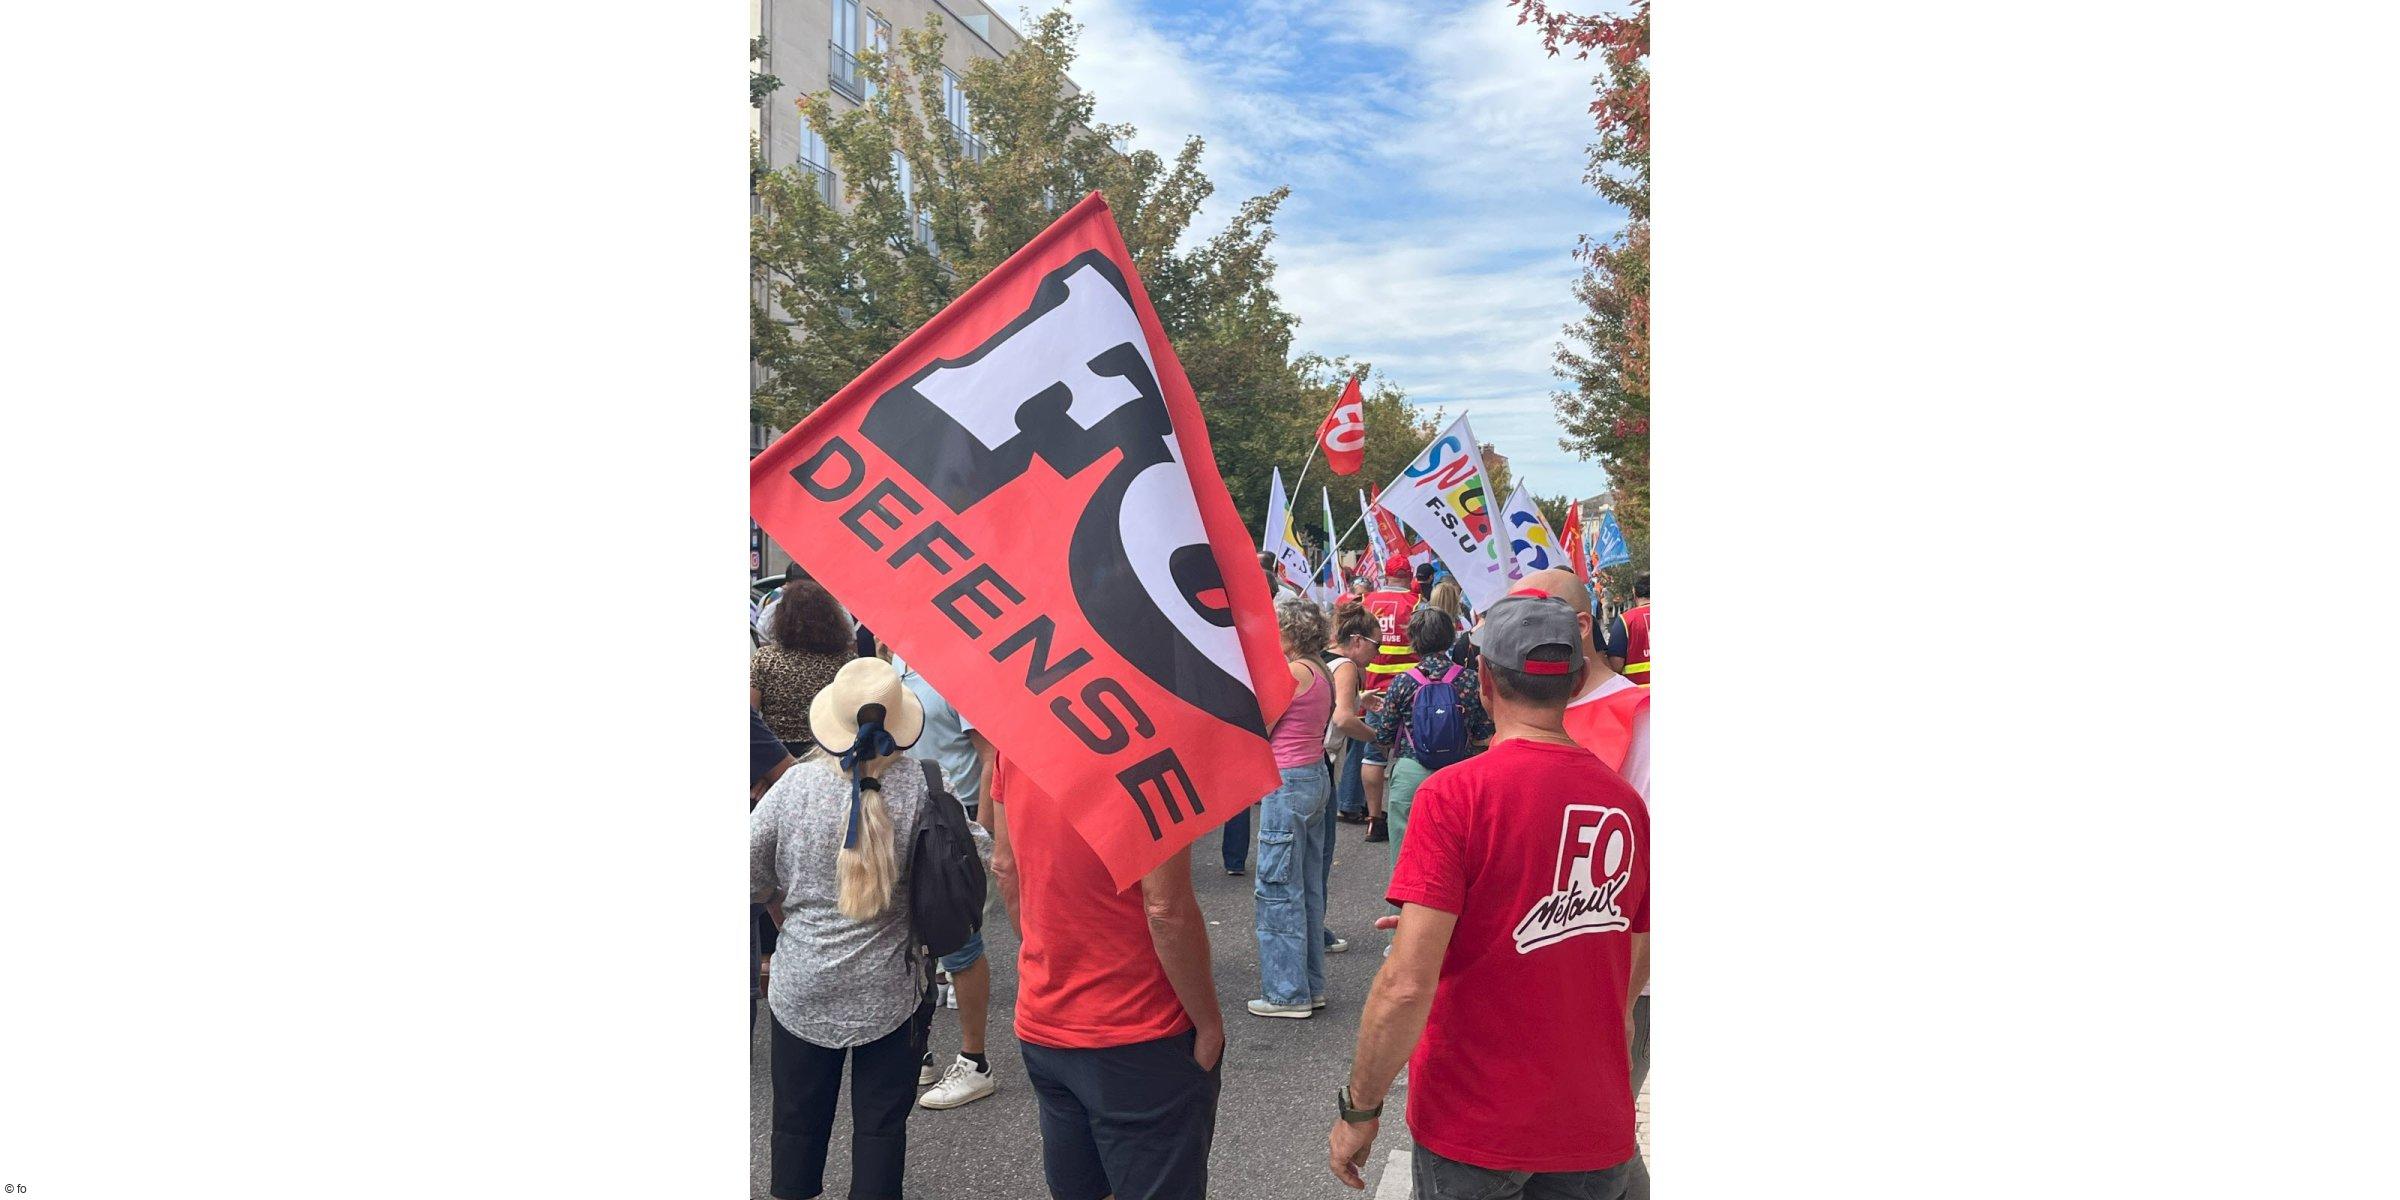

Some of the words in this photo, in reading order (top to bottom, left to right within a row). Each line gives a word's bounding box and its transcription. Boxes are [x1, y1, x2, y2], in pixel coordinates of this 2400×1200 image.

[1325, 402, 1364, 452] FO
[860, 249, 1268, 739] FO
[1425, 496, 1477, 553] F.S.U
[790, 436, 1205, 840] DEFENSE
[1379, 614, 1395, 632] gt
[1554, 804, 1635, 892] FO
[1518, 875, 1625, 935] Métaux
